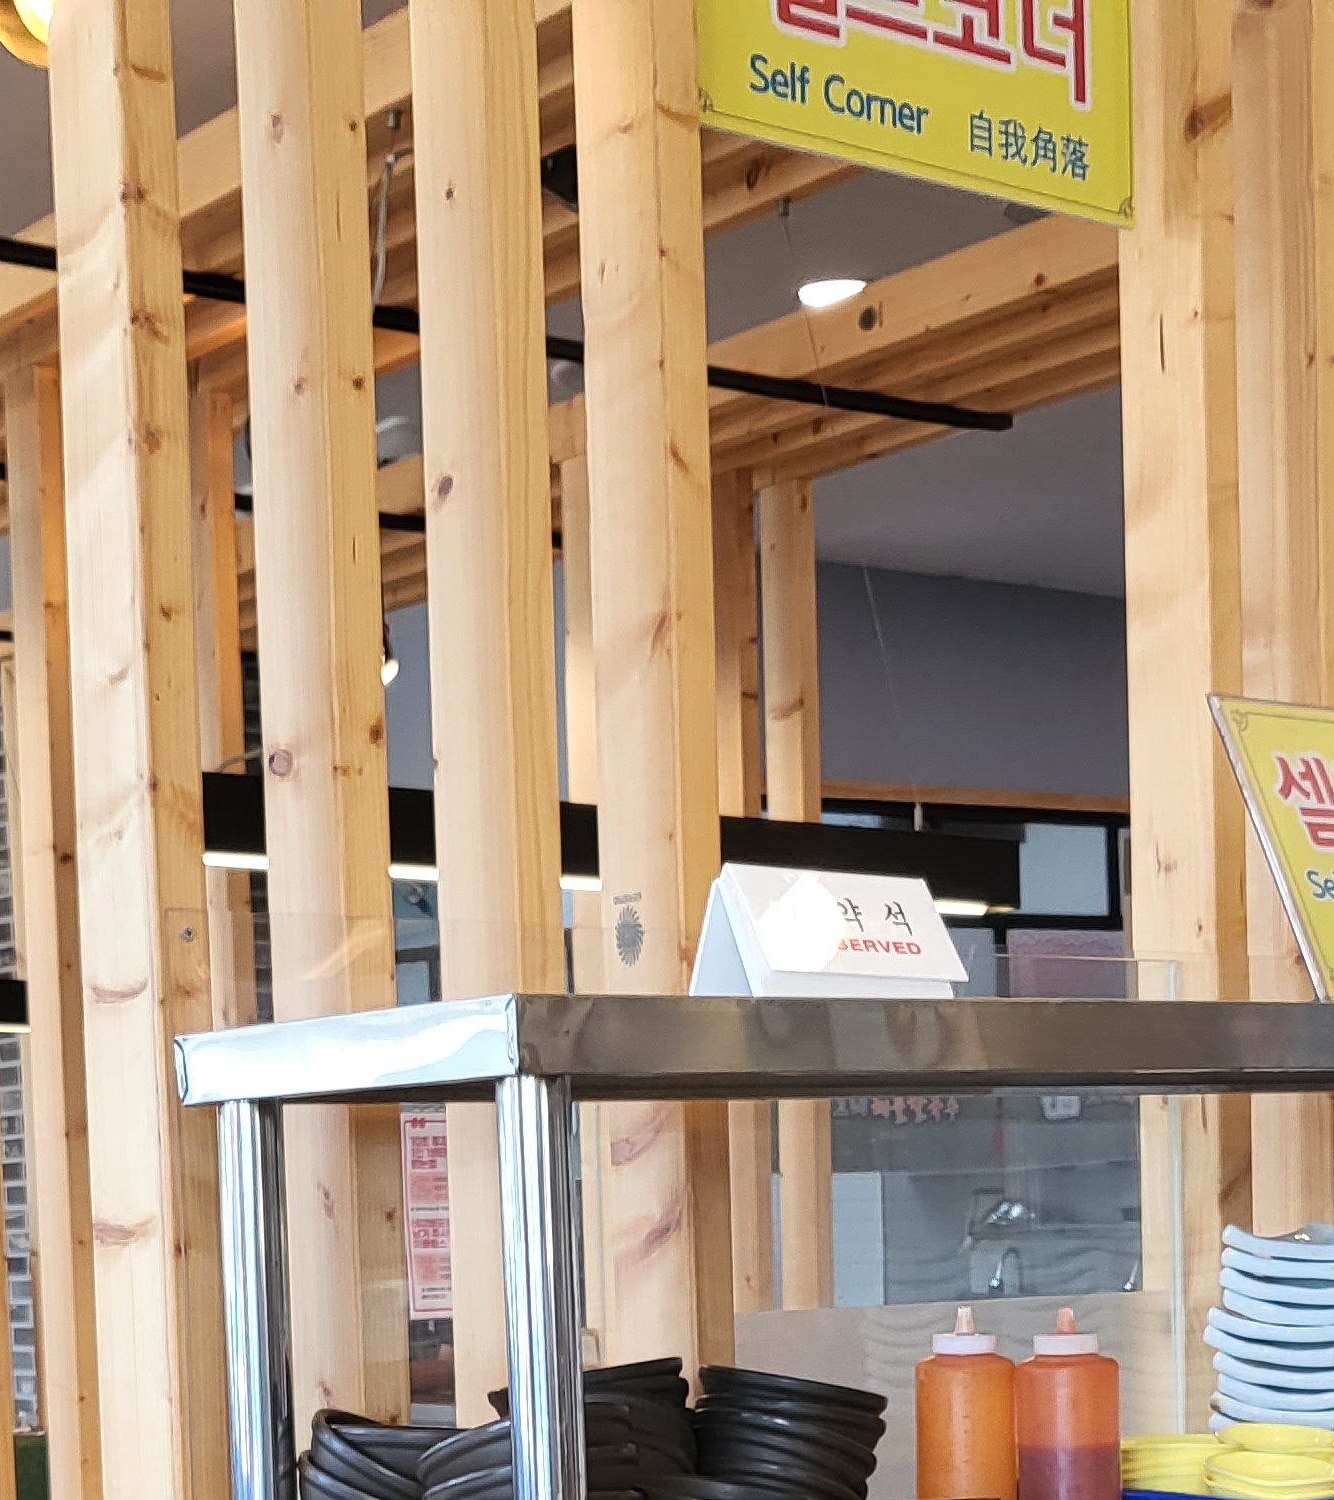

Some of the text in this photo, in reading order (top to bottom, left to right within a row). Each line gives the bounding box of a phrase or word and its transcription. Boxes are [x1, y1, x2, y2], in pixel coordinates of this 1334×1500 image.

[749, 54, 929, 135] Self Corner
[968, 110, 1090, 182] 自我角落
[837, 938, 921, 955] SERVED
